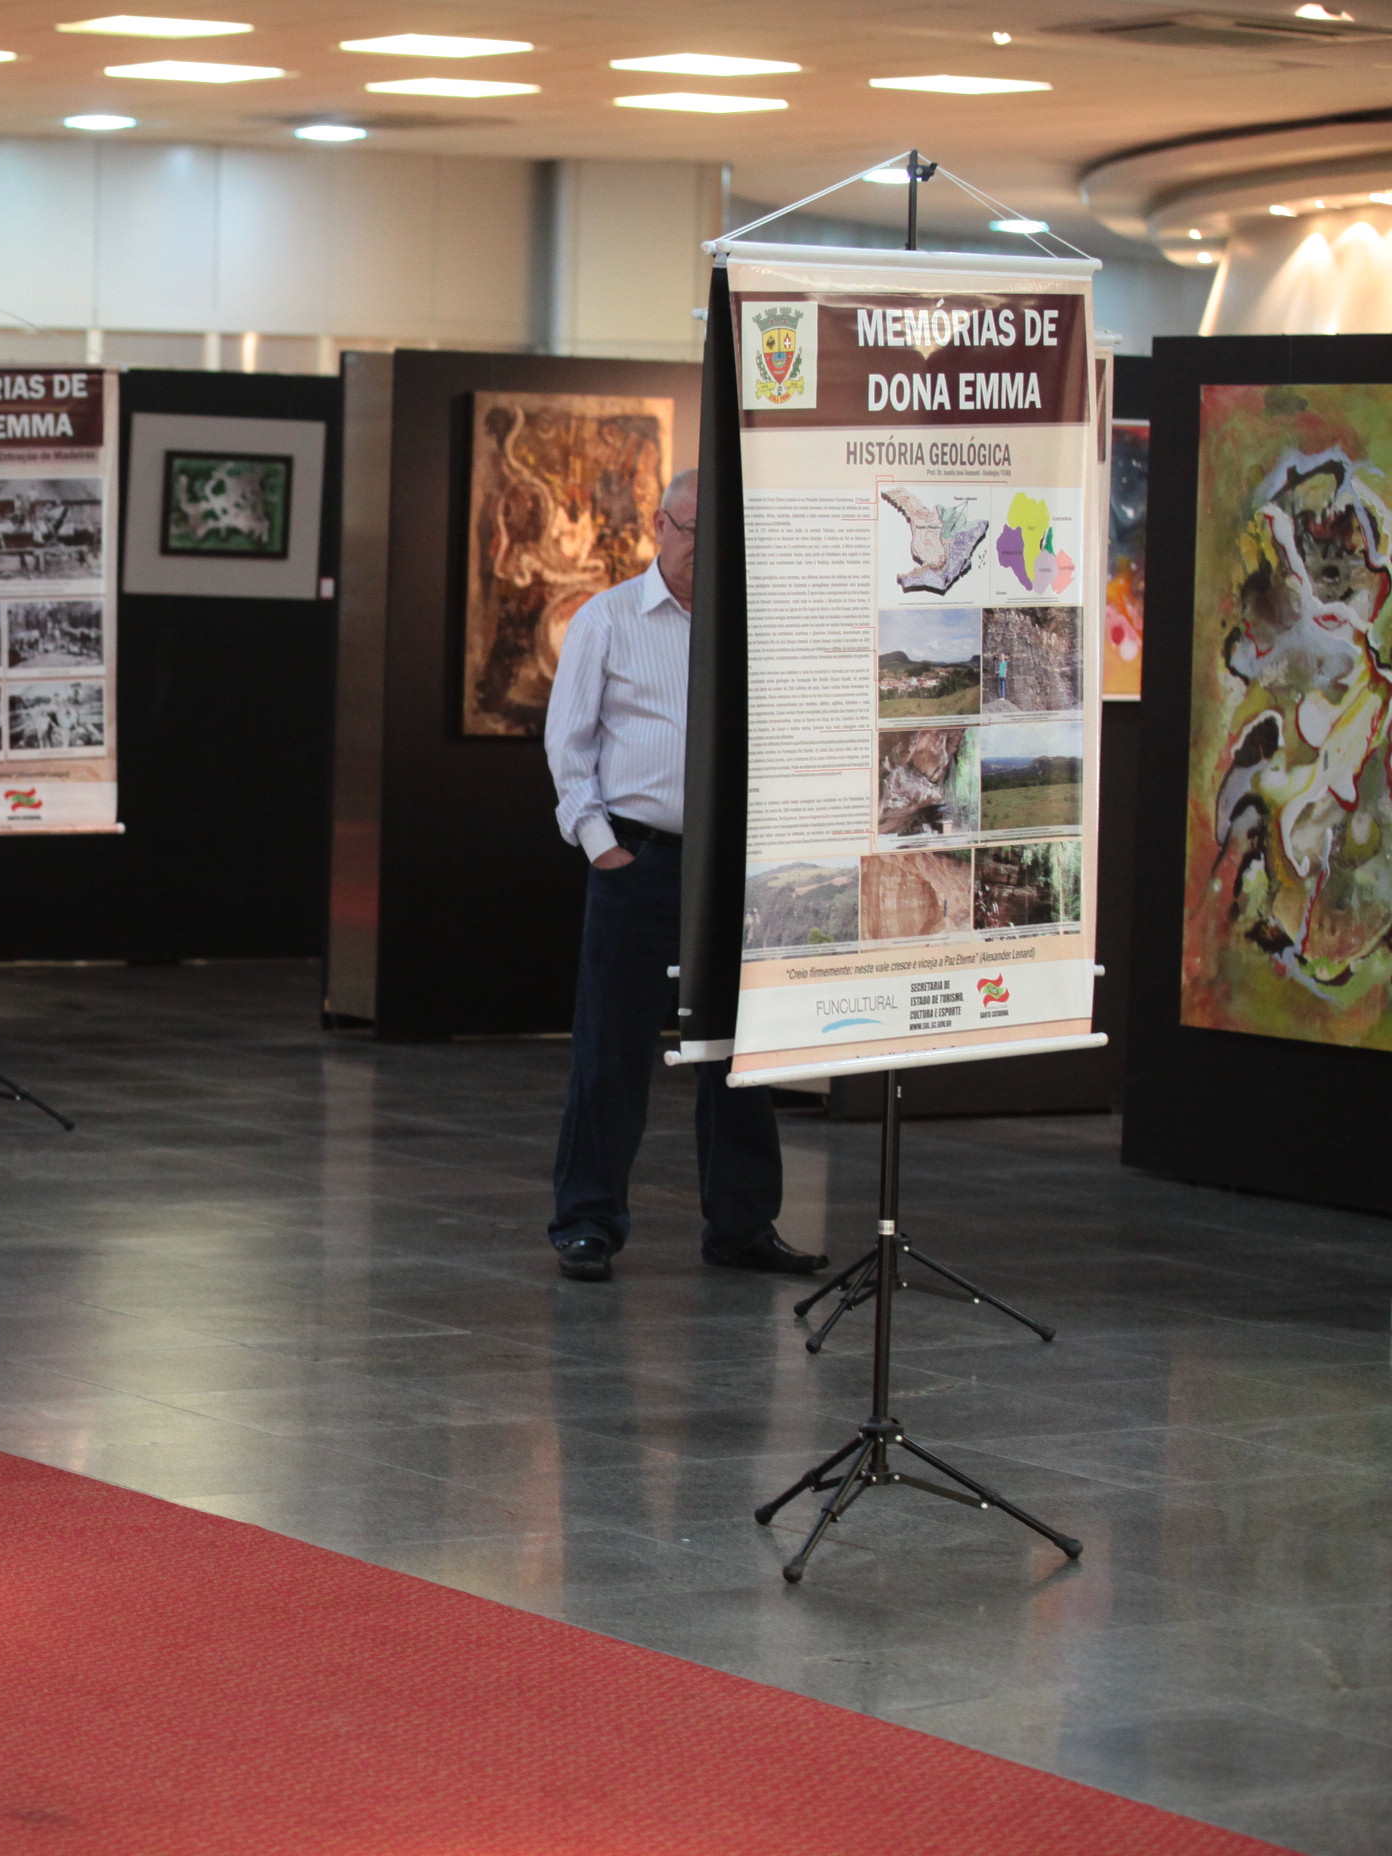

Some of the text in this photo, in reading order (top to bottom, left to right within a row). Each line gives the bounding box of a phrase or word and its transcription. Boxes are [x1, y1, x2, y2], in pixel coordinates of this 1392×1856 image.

[857, 297, 1059, 347] MEMÓRIAS DE
[52, 373, 89, 399] DE
[867, 372, 1042, 412] DONA EMMA
[846, 434, 1012, 467] HISTÓRIA GEOLÓGICA
[875, 962, 890, 972] vale
[912, 961, 917, 969] e
[938, 959, 943, 967] a
[944, 955, 956, 966] Paz
[910, 980, 950, 993] SECRETARIA DE
[815, 994, 898, 1016] FUNCULTURAL
[910, 994, 931, 1007] ESTADO
[931, 994, 939, 1004] DE
[910, 1006, 962, 1020] CULTURA E ESPORTE
